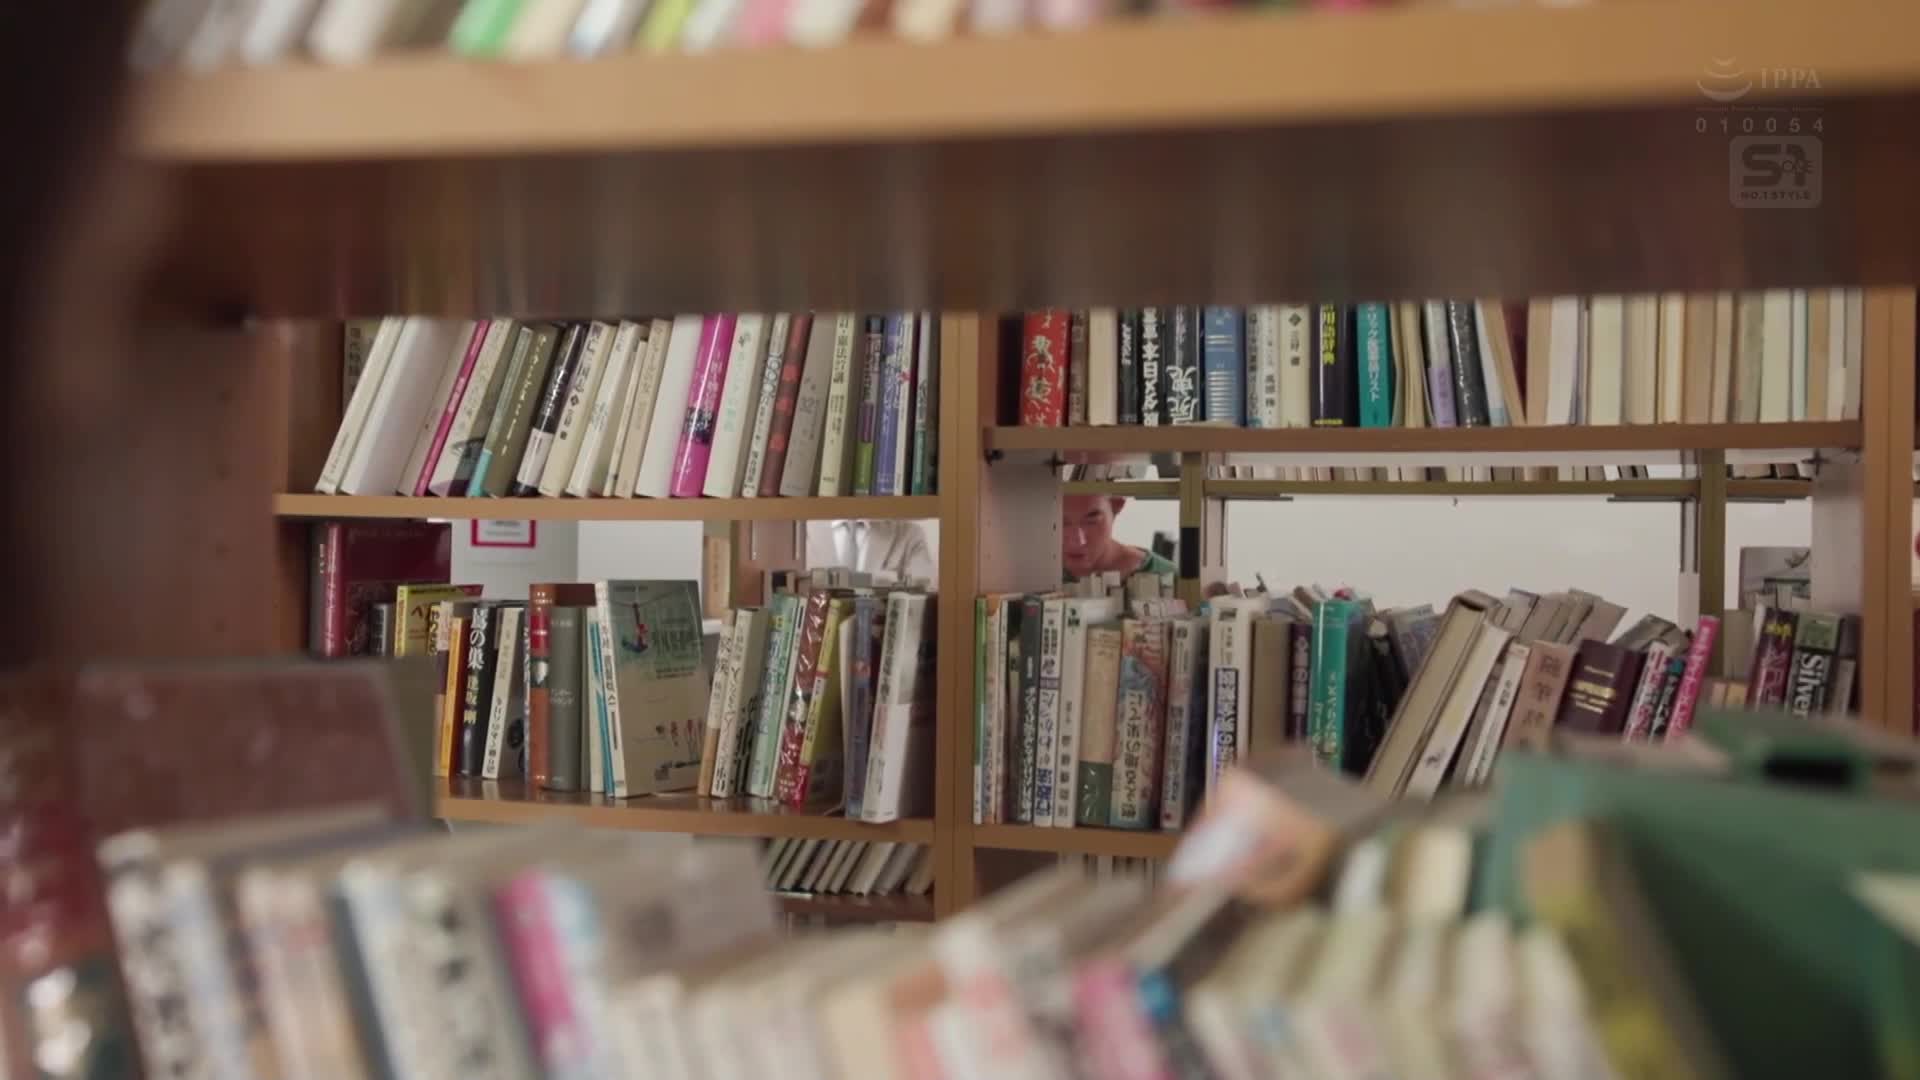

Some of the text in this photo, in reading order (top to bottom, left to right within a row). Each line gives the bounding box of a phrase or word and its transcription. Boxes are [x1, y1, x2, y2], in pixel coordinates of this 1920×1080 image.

[1166, 365, 1199, 425] 屍鬼
[1793, 652, 1825, 717] Silver
[1035, 689, 1055, 817] 行政法がわかった
[1121, 692, 1144, 818] 燃える地の果てに
